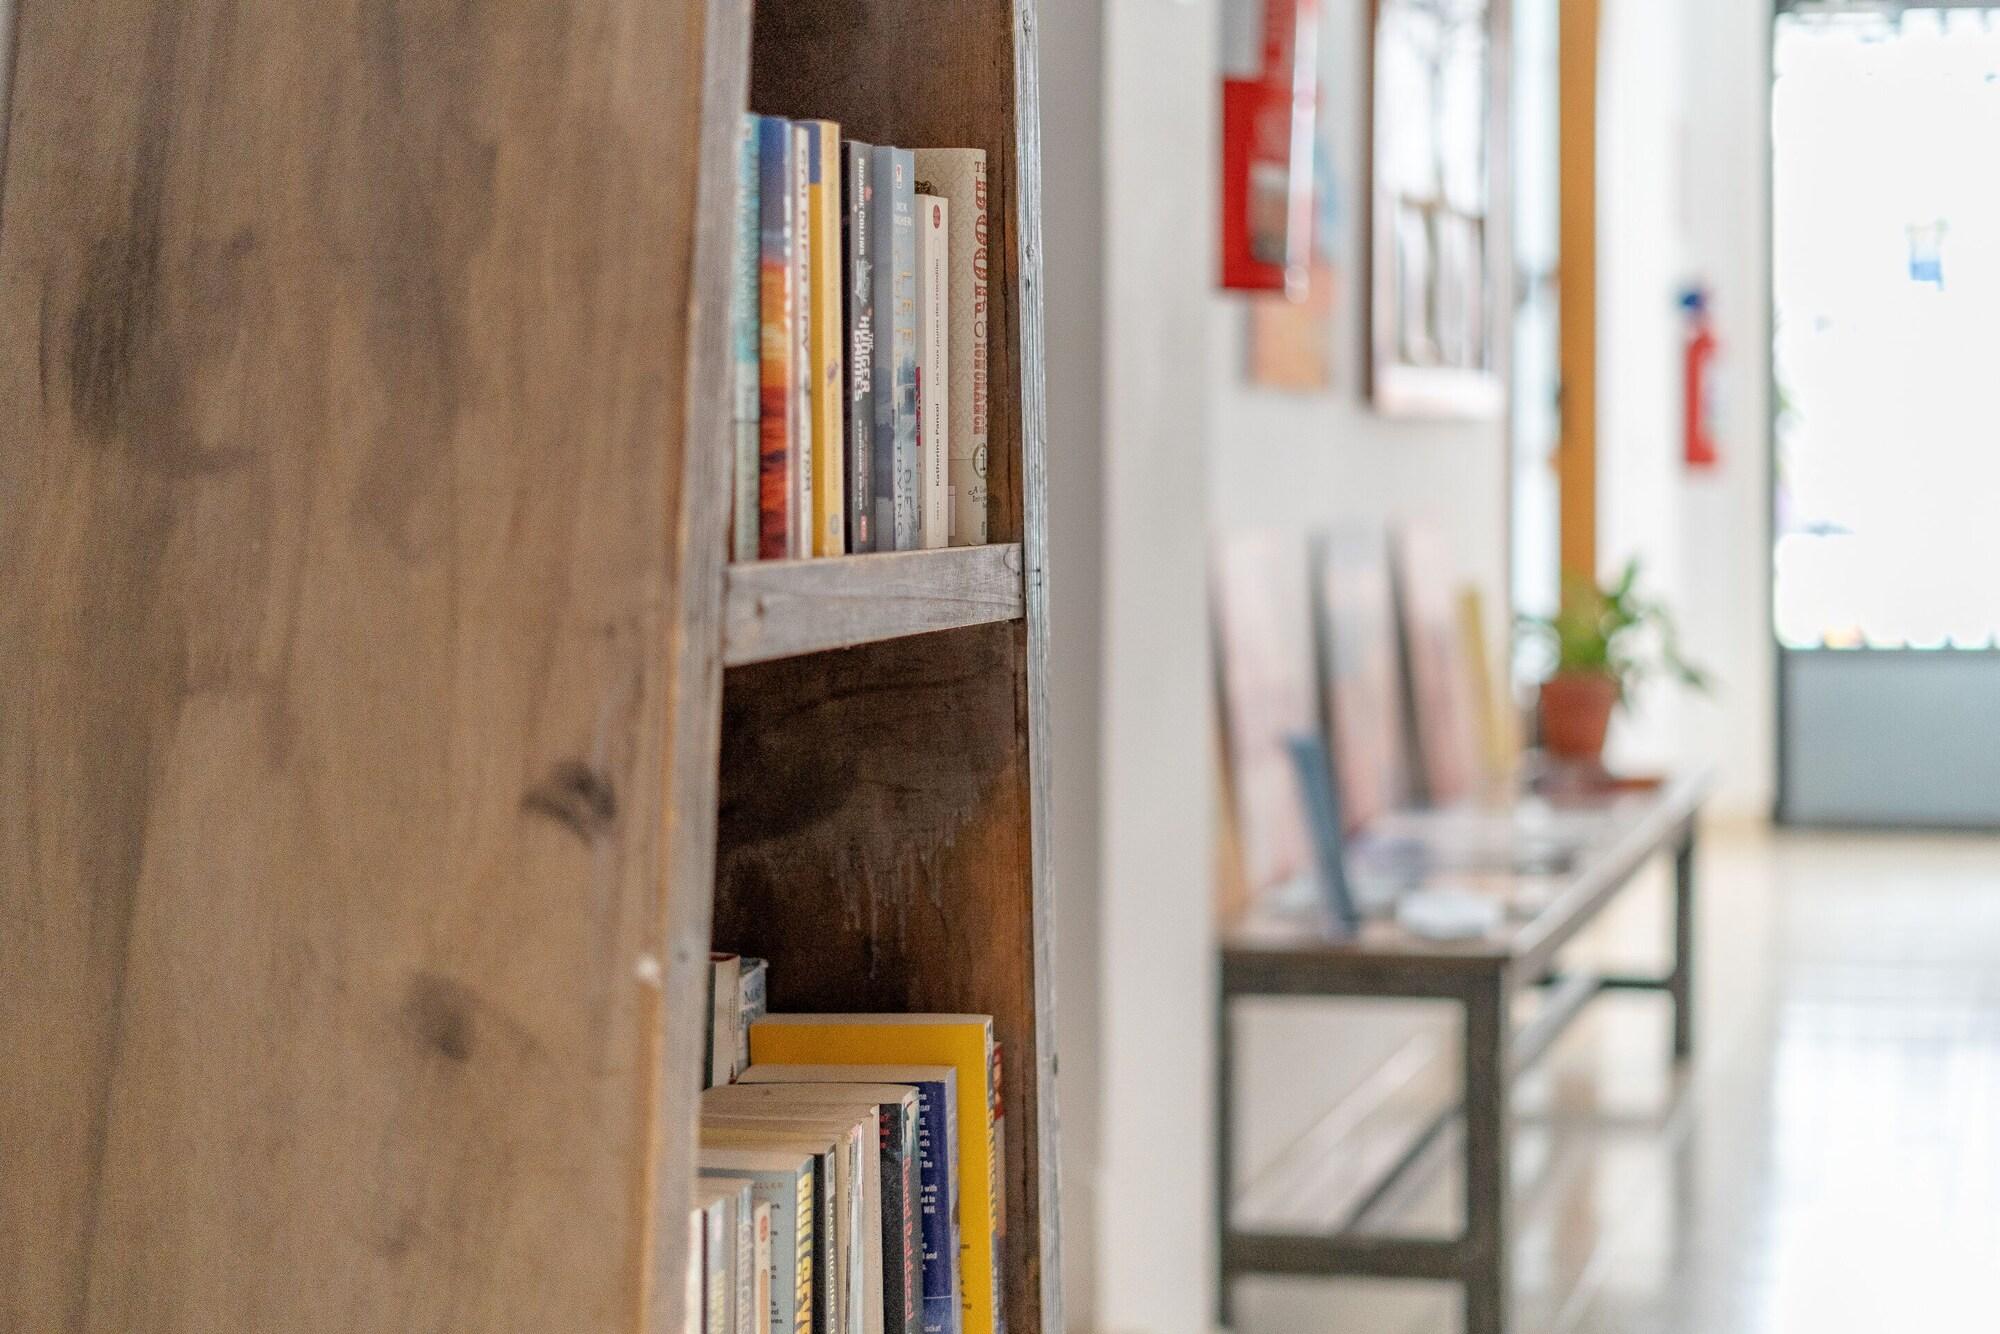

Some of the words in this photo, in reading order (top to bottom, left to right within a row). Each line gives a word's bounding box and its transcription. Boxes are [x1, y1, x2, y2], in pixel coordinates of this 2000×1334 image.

[857, 157, 865, 209] SUZANNE
[858, 210, 866, 255] COLLINS
[902, 270, 912, 345] LEE
[854, 329, 863, 402] GAMES
[858, 315, 871, 393] HUNGER
[896, 441, 904, 537] TRYING
[903, 468, 912, 510] DIE
[903, 1156, 913, 1220] David
[924, 1183, 938, 1192] with
[929, 1195, 936, 1203] to
[827, 1202, 835, 1241] MARY
[828, 1247, 836, 1314] HIGGINS
[904, 1221, 915, 1321] Baldacci
[926, 1251, 938, 1260] and
